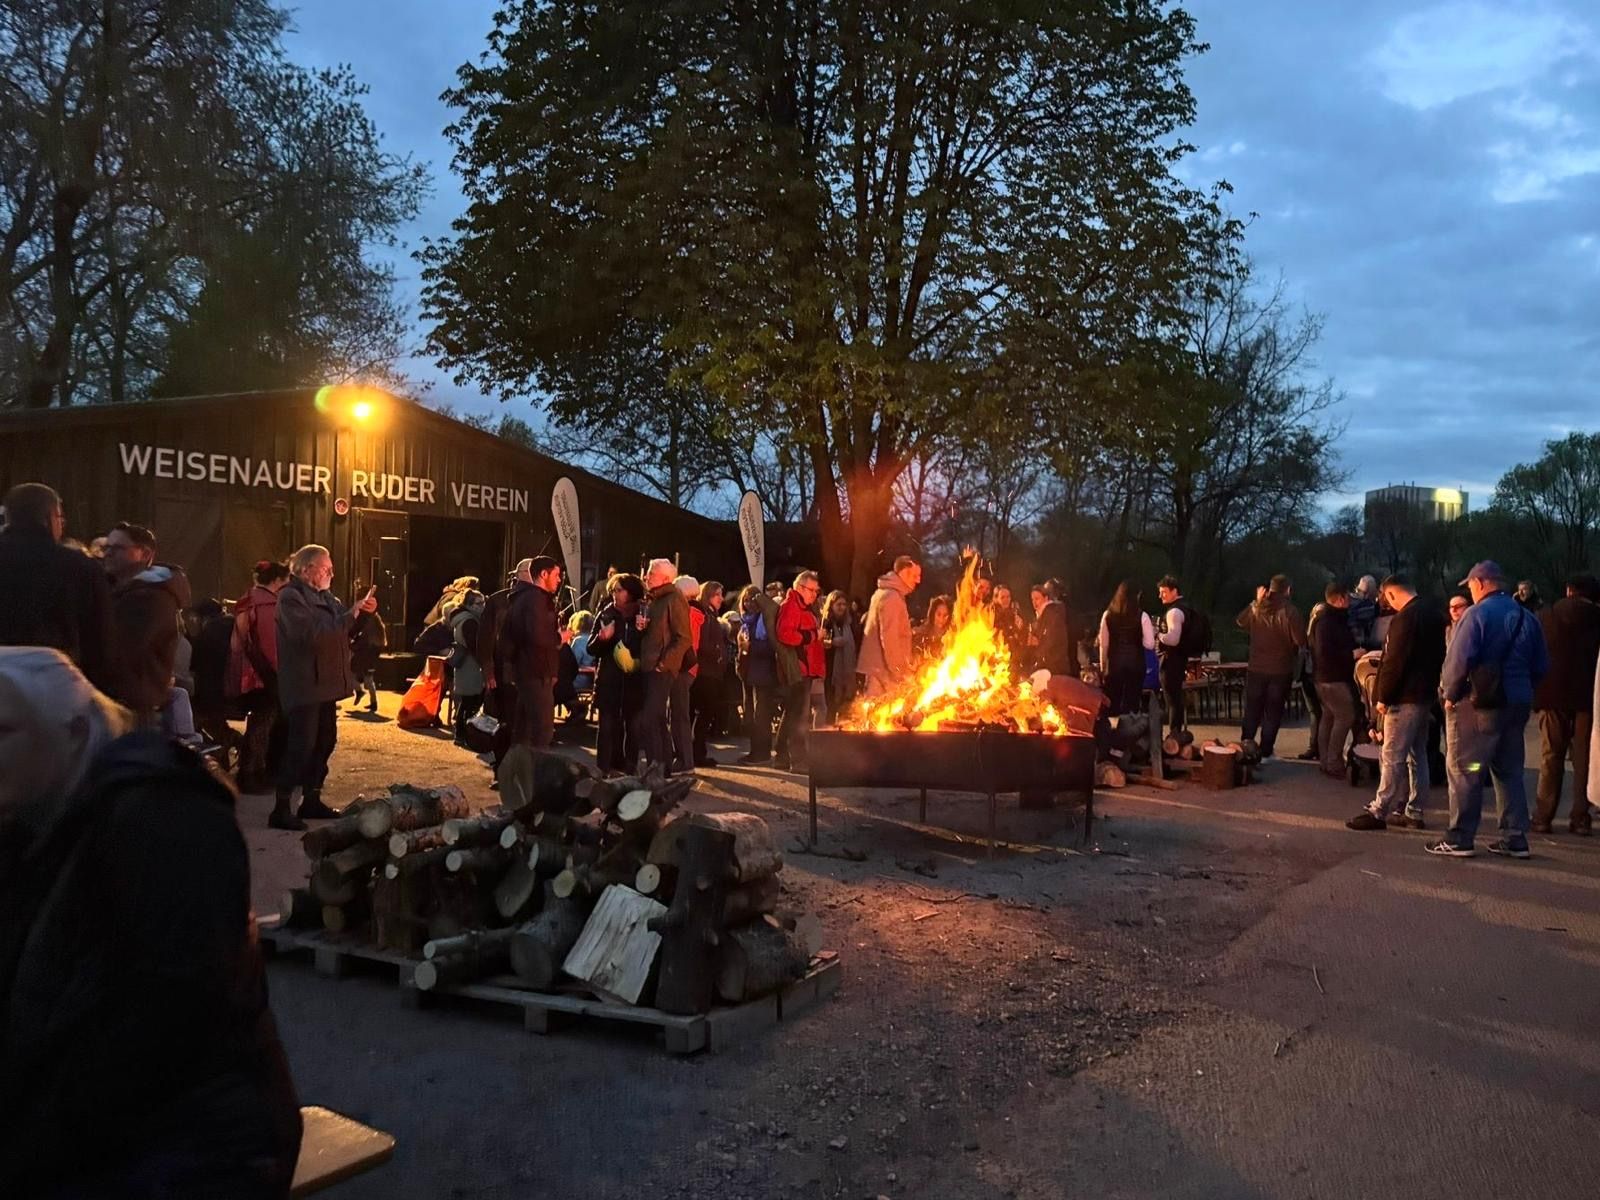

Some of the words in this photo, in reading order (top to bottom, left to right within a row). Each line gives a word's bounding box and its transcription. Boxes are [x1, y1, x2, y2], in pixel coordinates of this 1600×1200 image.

[120, 443, 331, 493] WEISENAUER
[352, 469, 435, 503] RUDER
[452, 482, 529, 513] VEREIN
